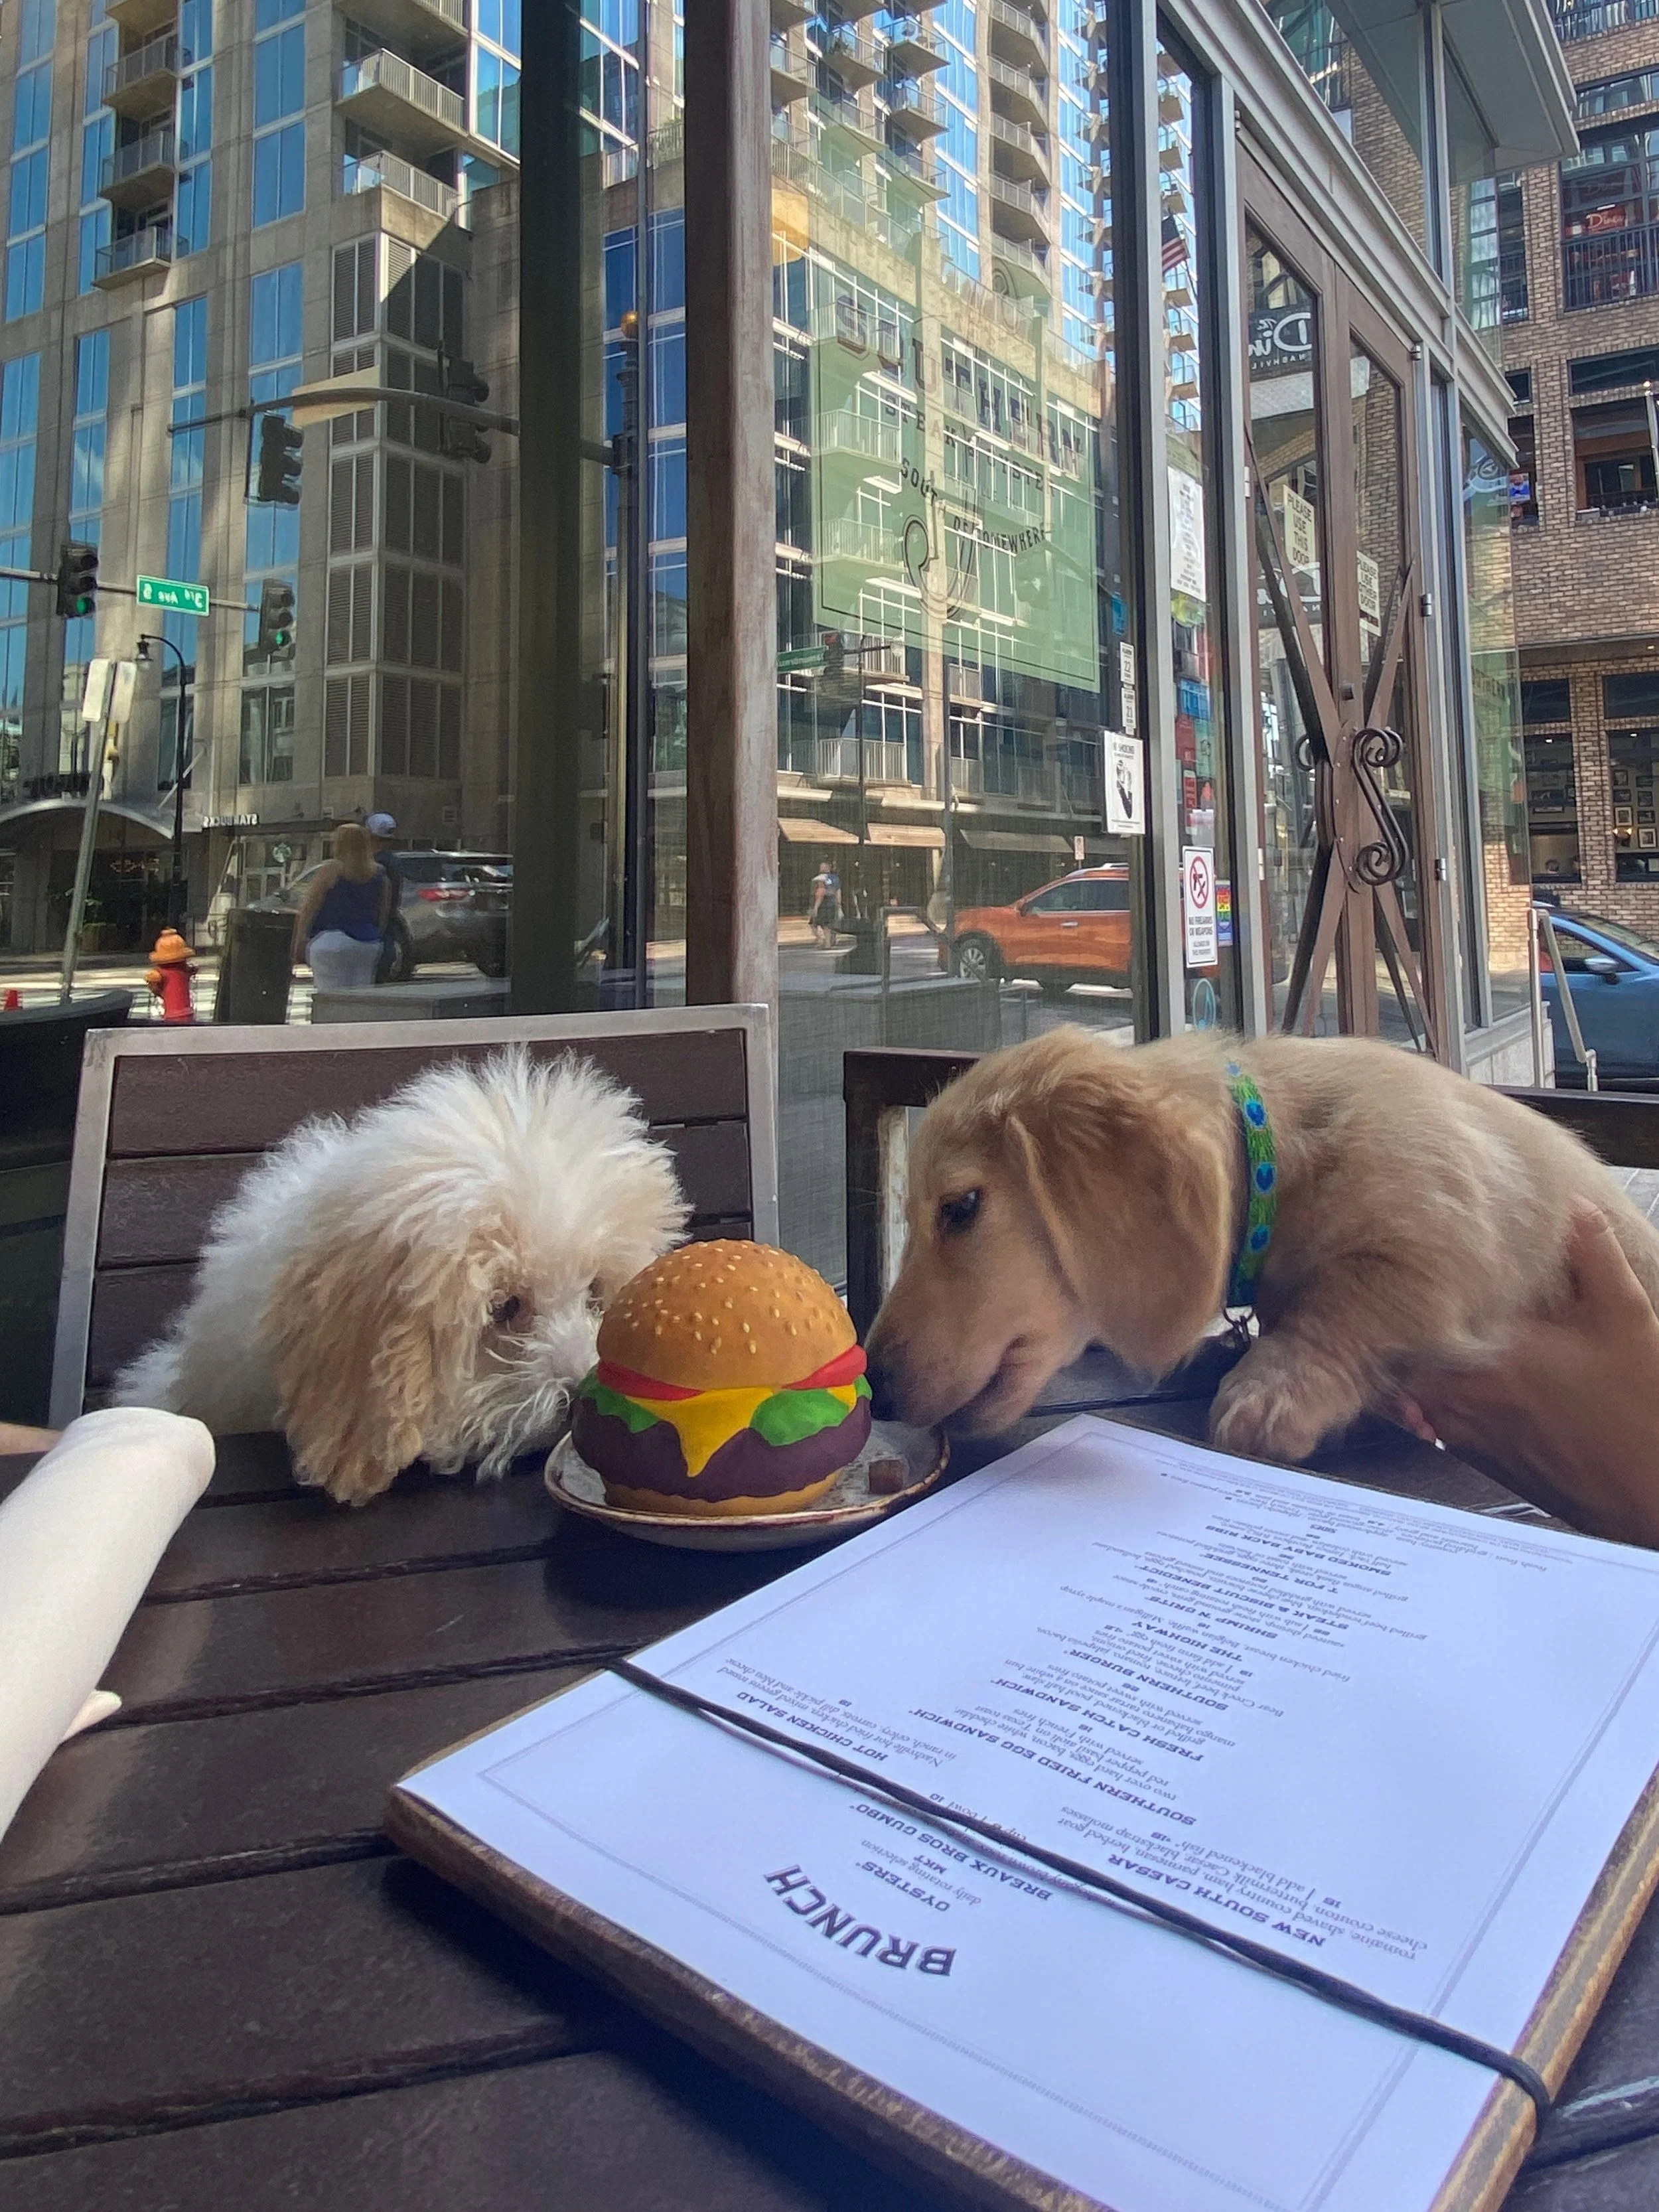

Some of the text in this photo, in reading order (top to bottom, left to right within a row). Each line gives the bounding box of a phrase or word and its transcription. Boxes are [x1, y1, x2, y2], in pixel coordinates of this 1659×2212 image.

[885, 393, 956, 449] STEAK
[1287, 493, 1313, 523] PLEASE
[1294, 516, 1307, 535] USE
[1294, 531, 1309, 552] THIS
[1327, 1556, 1391, 1576] SMOKED
[1293, 1577, 1325, 1589] FOR
[1212, 1587, 1275, 1609] BISCUIT
[1214, 1617, 1277, 1639] SHRIMP
[1291, 1610, 1348, 1629] STEAK
[1131, 1621, 1242, 1662] THE HIGHWAY
[725, 1658, 756, 1674] cheese
[748, 1680, 782, 1696] greens
[771, 1680, 794, 1692] and
[1106, 1686, 1138, 1701] sweet
[1135, 1674, 1228, 1710] SOUTHERN
[774, 1693, 809, 1711] mixed
[793, 1690, 826, 1706] pickle
[1108, 1696, 1143, 1712] tartar
[1139, 1698, 1163, 1712] with
[818, 1703, 840, 1714] dill
[1163, 1709, 1202, 1726] served
[736, 1691, 889, 1761] HOT CHICKEN SALAD
[844, 1724, 874, 1740] fried
[996, 1722, 1027, 1738] white
[1001, 1714, 1031, 1732] Texas
[1035, 1726, 1051, 1736] on
[1081, 1709, 1141, 1737] CATCH
[1141, 1710, 1194, 1734] habanero
[1149, 1723, 1165, 1732] or
[872, 1735, 893, 1748] hot
[1012, 1708, 1144, 1765] served with French fries
[1163, 1728, 1206, 1745] grilled
[1195, 1730, 1236, 1747] mango
[893, 1743, 943, 1767] Nashville
[1000, 1741, 1037, 1759] EGG
[1074, 1745, 1106, 1762] basil
[1141, 1735, 1204, 1761] FRESH
[1037, 1756, 1093, 1784] FRIED
[1092, 1763, 1124, 1781] hard
[1104, 1757, 1149, 1778] pepper
[1123, 1776, 1151, 1790] over
[1145, 1775, 1169, 1787] red
[927, 1792, 946, 1803] 10
[1093, 1781, 1196, 1825] SOUTHERN
[1153, 1787, 1177, 1801] two
[944, 1801, 979, 1819] bowl
[1060, 1806, 1114, 1831] molasses
[916, 1833, 973, 1863] BROS
[1115, 1827, 1180, 1860] blackstrap
[861, 1839, 981, 1905] daily rotating selection
[913, 1854, 947, 1874] MKT
[1108, 1854, 1191, 1890] CAESAR
[1204, 1850, 1275, 1883] blackened
[969, 1859, 1052, 1901] BREAUX
[1056, 1817, 1415, 1960] romaine, shaved country ham, parmesan, herbed goat
[1275, 1876, 1305, 1891] add
[1232, 1872, 1309, 1911] buttermilk
[1192, 1885, 1269, 1923] SOUTH
[764, 1866, 955, 1976] BRUNCH
[1313, 1904, 1374, 1932] crouton,
[1271, 1921, 1326, 1947] NEW
[1376, 1927, 1427, 1951] cheese
